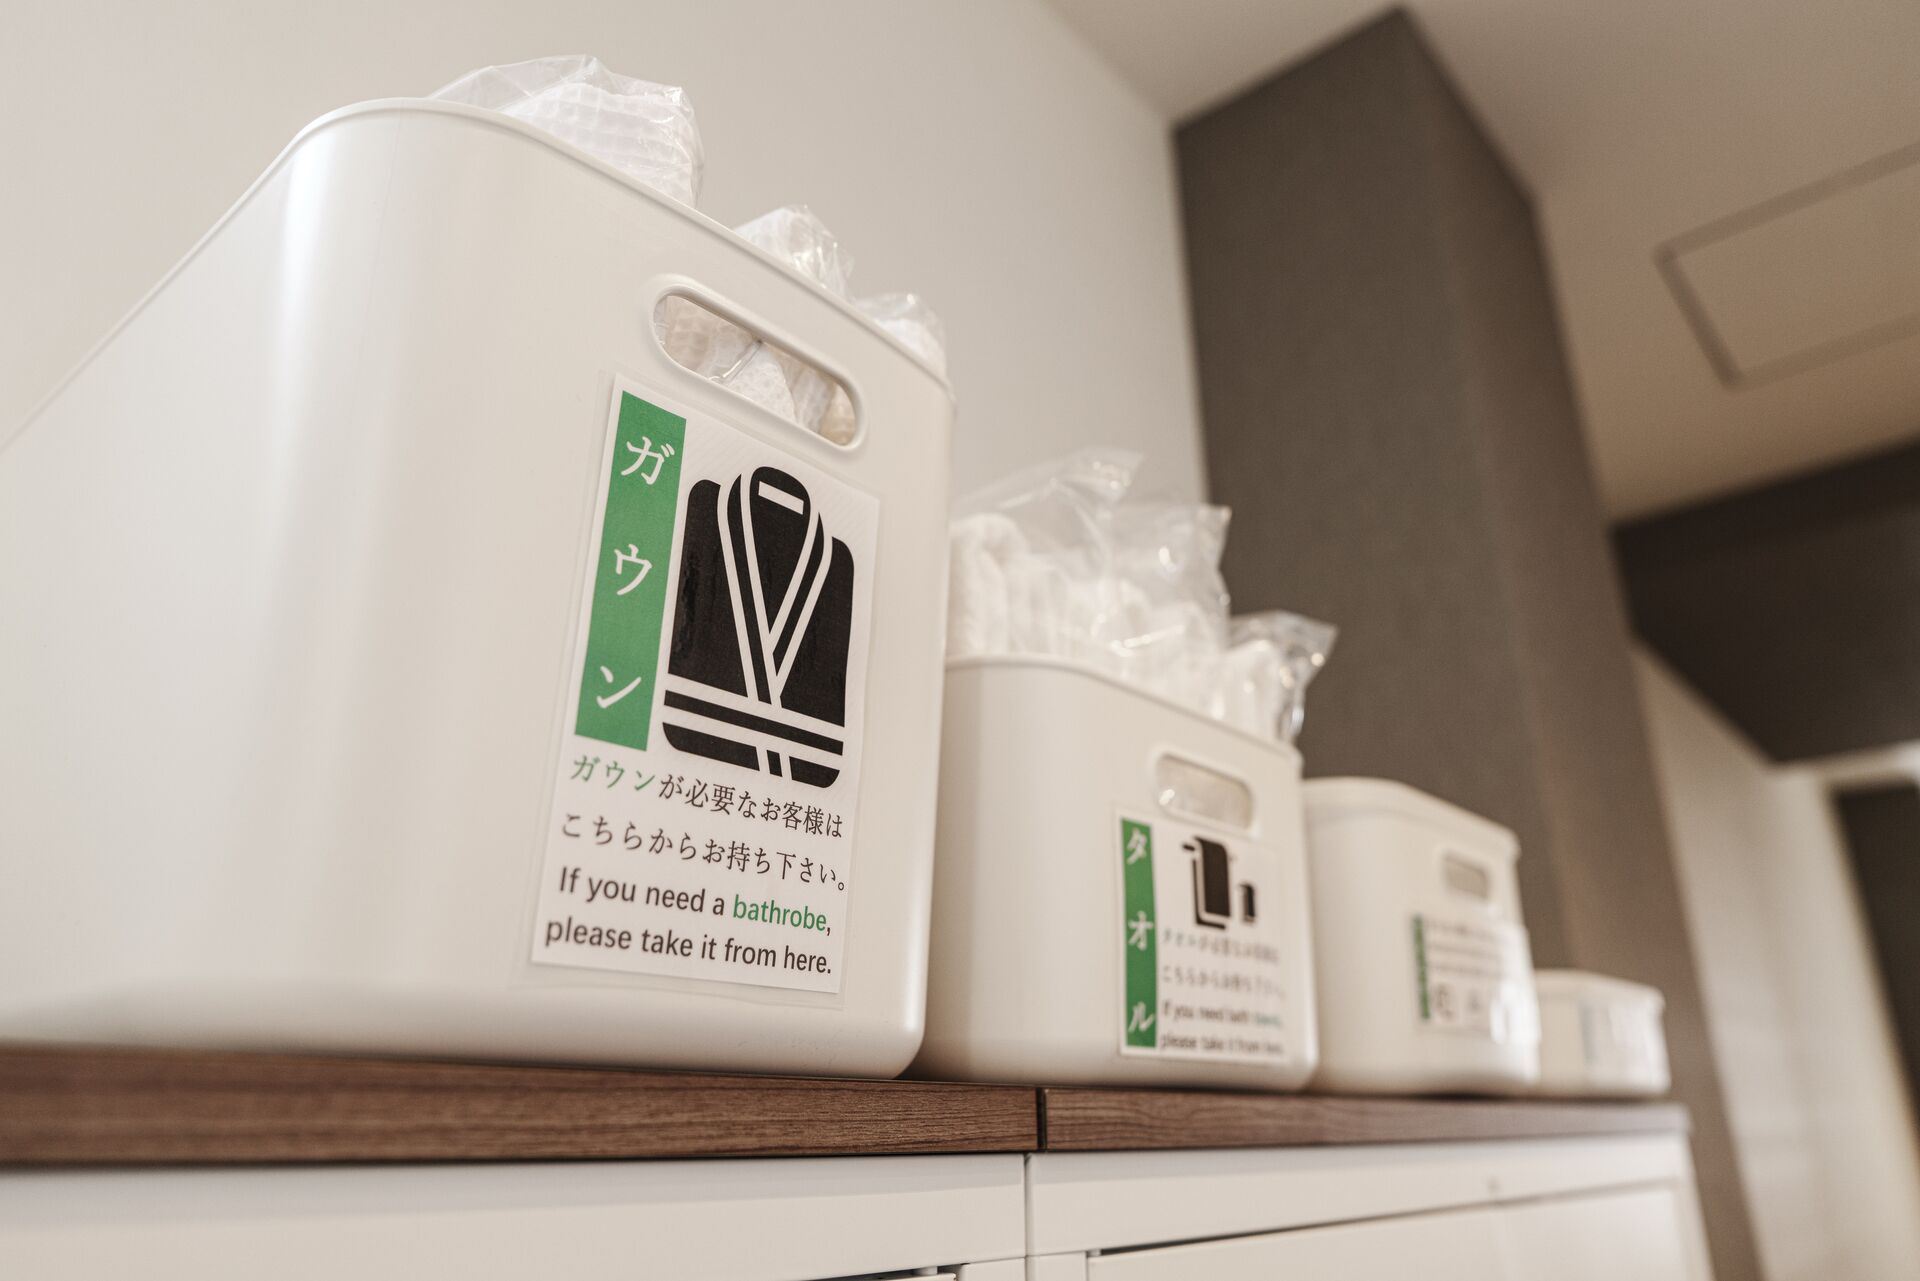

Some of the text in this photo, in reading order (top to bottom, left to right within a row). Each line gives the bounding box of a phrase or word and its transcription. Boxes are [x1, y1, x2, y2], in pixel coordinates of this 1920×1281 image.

[596, 436, 675, 709] ガウン
[570, 754, 843, 839] ガウンが必要なお客様は
[562, 813, 845, 891] こちらからお持ち下さい。
[559, 866, 831, 936] If you need a bathrobe,
[1127, 828, 1155, 1033] タオル
[545, 916, 831, 974] please take it from here.
